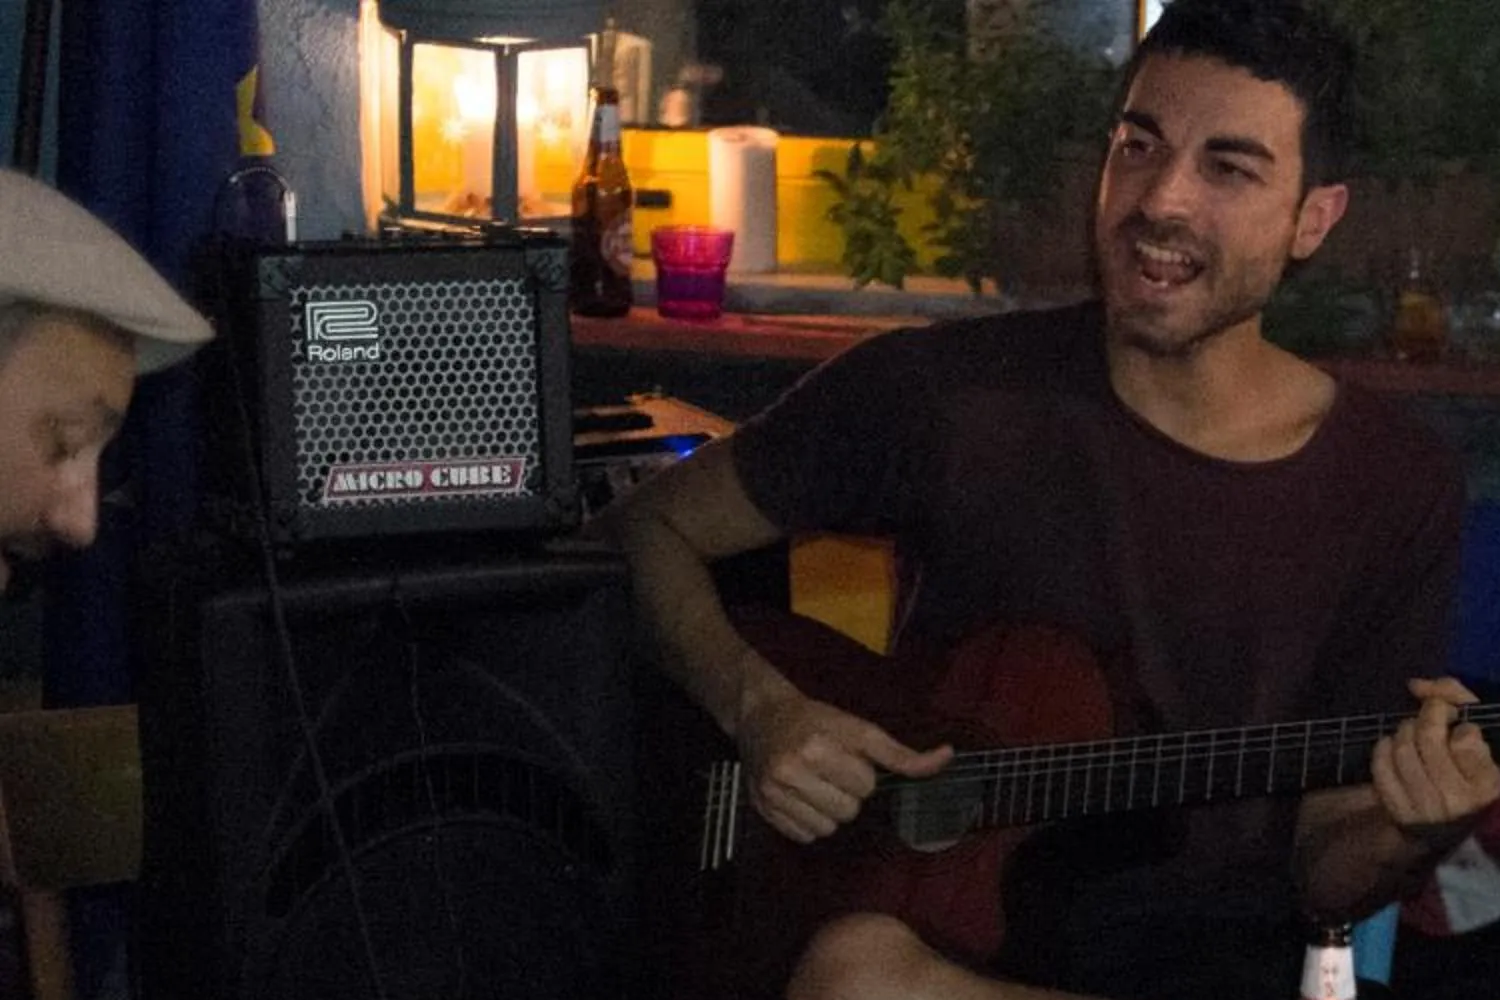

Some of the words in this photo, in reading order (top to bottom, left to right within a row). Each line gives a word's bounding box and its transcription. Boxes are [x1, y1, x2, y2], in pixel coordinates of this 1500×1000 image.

[307, 342, 380, 361] Roland
[333, 468, 423, 492] MICRO
[430, 464, 512, 487] CUBE
